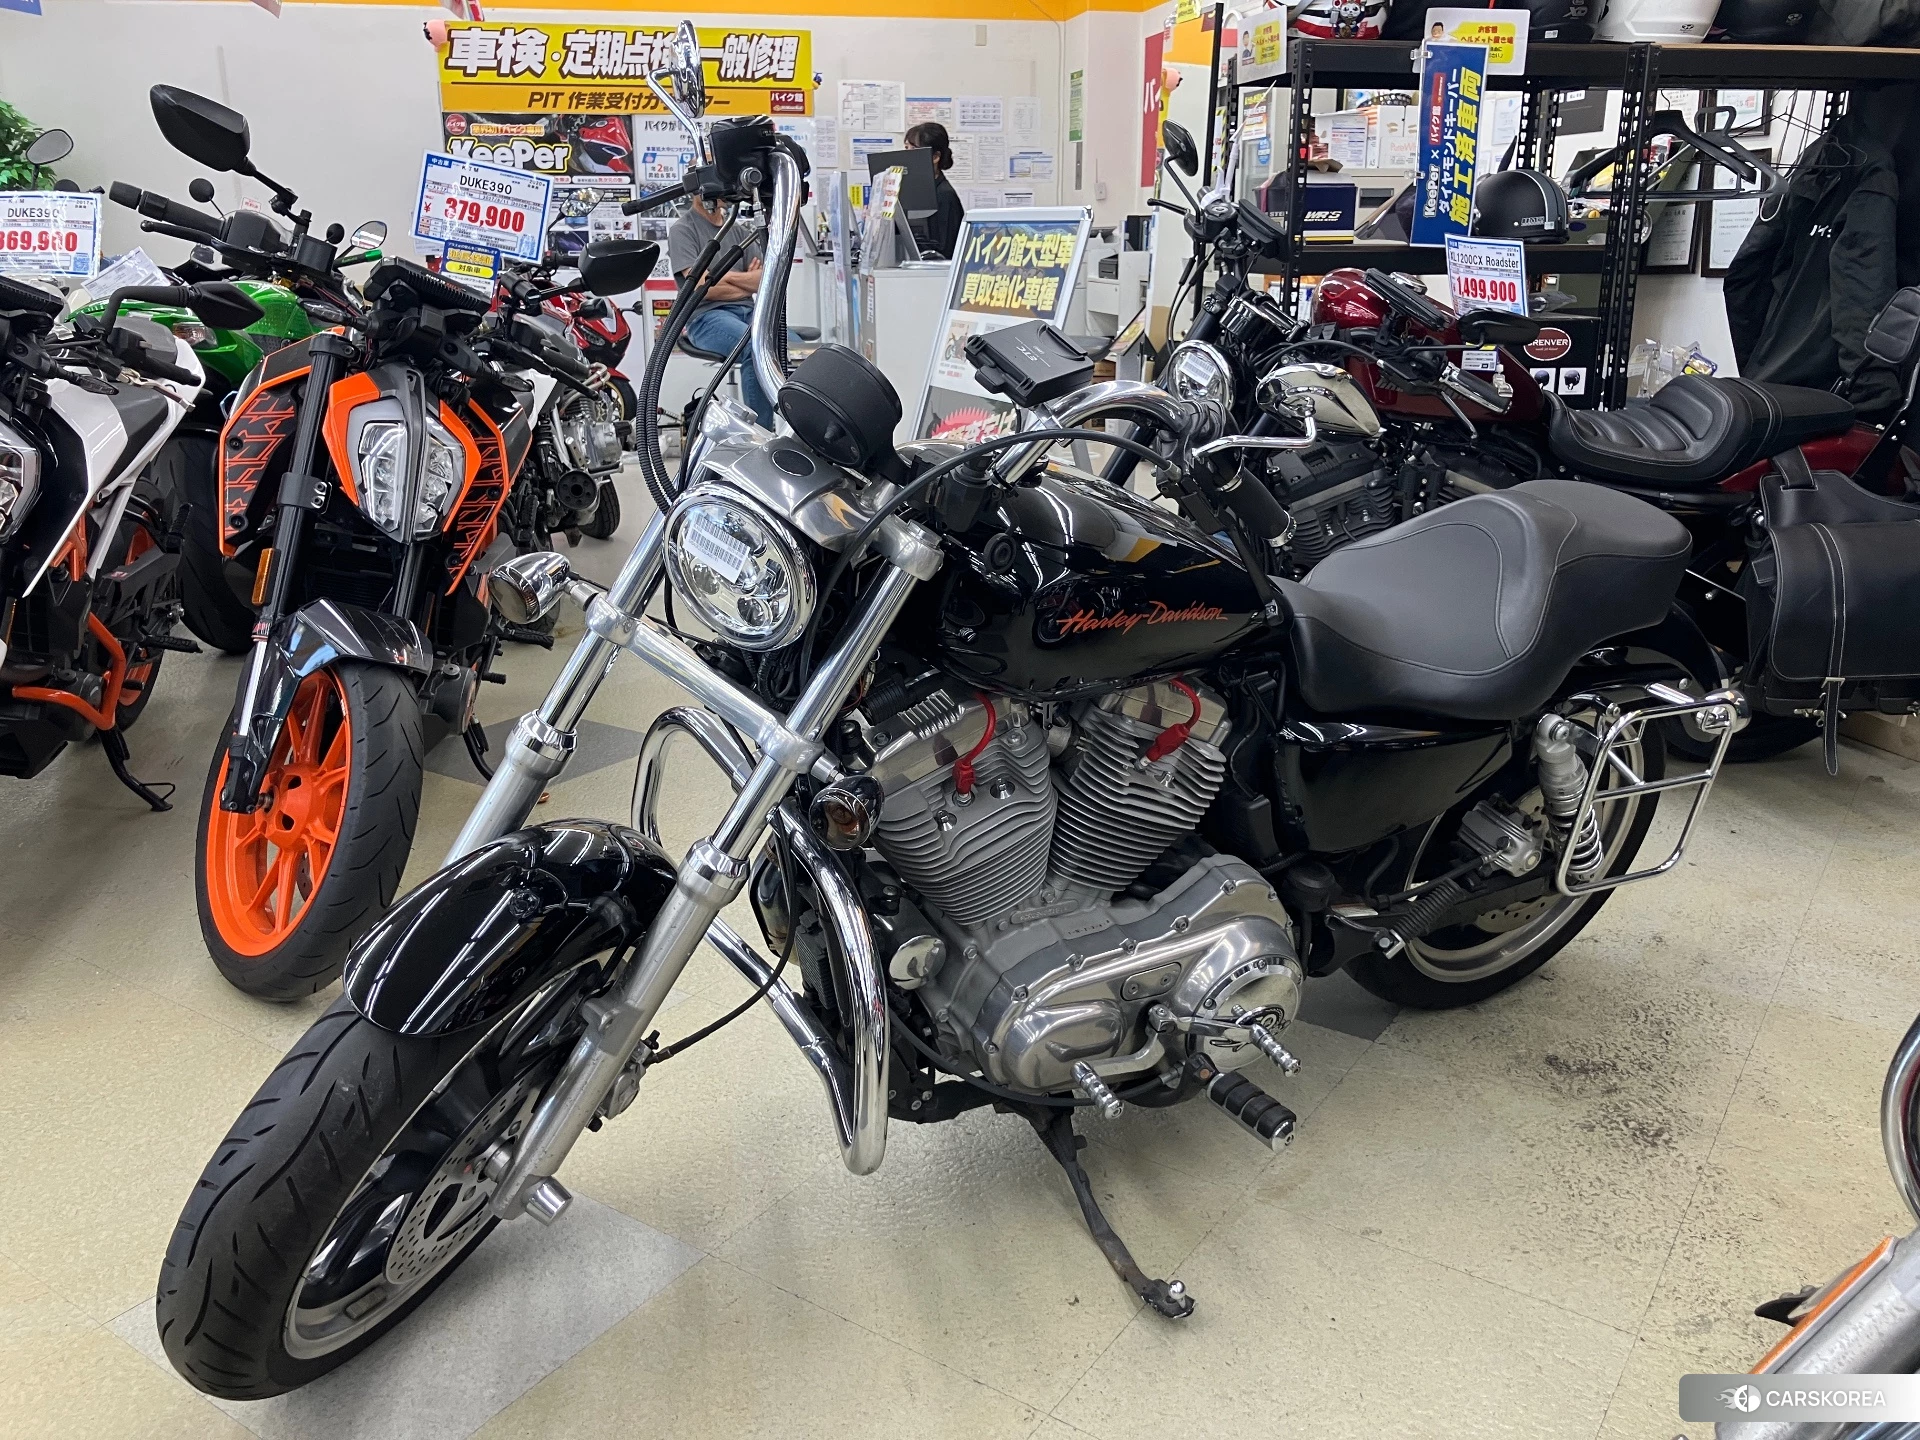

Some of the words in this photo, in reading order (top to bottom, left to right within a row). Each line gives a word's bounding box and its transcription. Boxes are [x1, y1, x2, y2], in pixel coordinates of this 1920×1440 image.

[447, 28, 799, 80] 車検・定期点一般修理
[527, 91, 566, 109] PIT
[771, 92, 804, 103] バイク館
[1438, 68, 1460, 215] ダイヤモンドキーパー
[1450, 66, 1482, 227] 施工済車両
[459, 175, 512, 195] DUKE390
[1424, 163, 1441, 219] KeePer
[7, 208, 60, 218] DUKE390
[444, 197, 525, 233] 379,900
[458, 265, 481, 273] 対象車
[965, 233, 1076, 269] バイク館大型車
[1485, 256, 1519, 269] Roadster
[961, 274, 1059, 310] 買取強化車種
[1456, 276, 1517, 303] 1,499,900
[1055, 599, 1229, 636] Harley-Davidson
